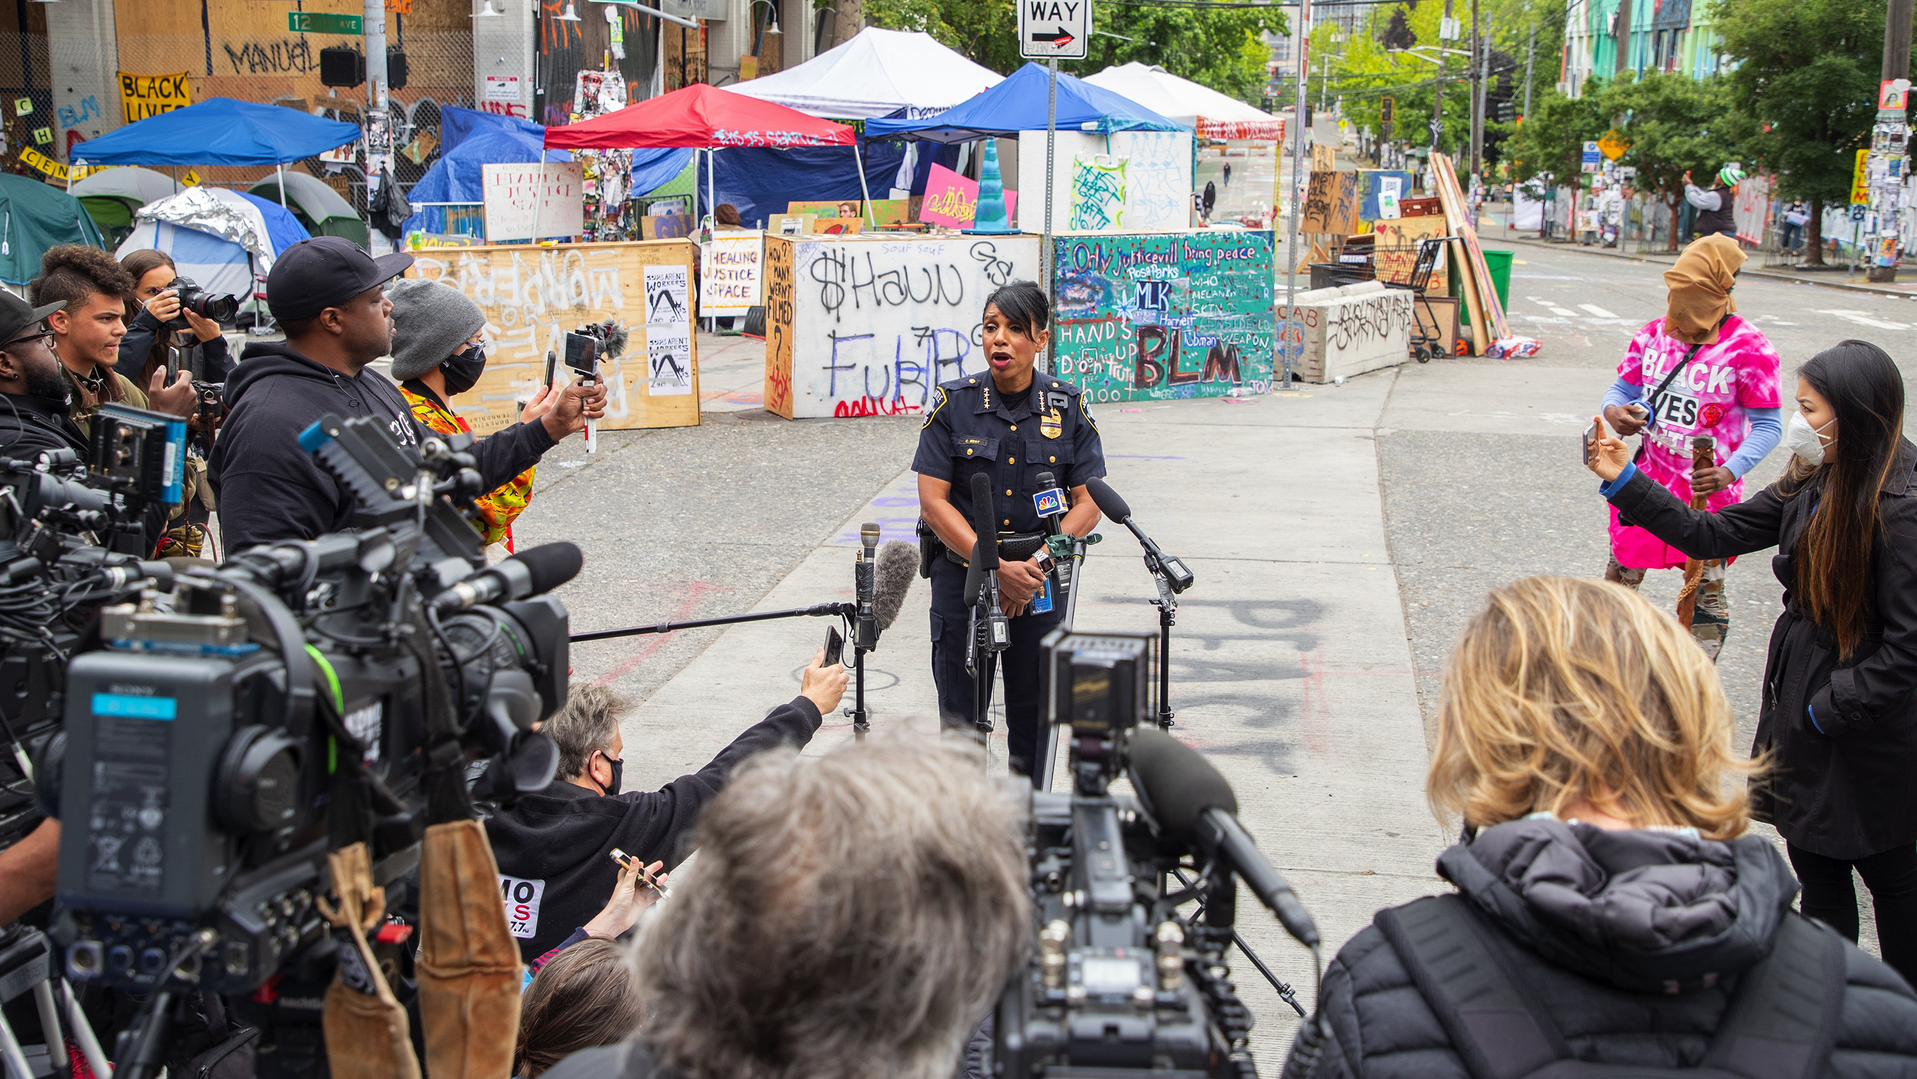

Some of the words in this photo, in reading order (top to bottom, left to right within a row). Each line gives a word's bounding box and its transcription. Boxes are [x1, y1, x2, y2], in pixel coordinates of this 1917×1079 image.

[293, 14, 311, 30] 12
[339, 20, 357, 30] AVE
[1031, 2, 1079, 21] WAY
[122, 76, 187, 99] BLACK
[57, 95, 100, 128] BLM
[125, 102, 186, 124] LIV
[503, 184, 576, 199] JUSICE
[511, 198, 554, 211] SPAE
[709, 251, 758, 265] HEALING
[1183, 239, 1212, 267] bring
[774, 264, 790, 282] MANY
[646, 280, 686, 293] WORKERS
[706, 283, 751, 299] SPACE
[1134, 281, 1171, 312] MLK
[767, 295, 793, 327] FILMED
[1061, 320, 1132, 344] HANDS
[1220, 332, 1269, 348] WEAPON
[1115, 342, 1138, 366] UP
[1134, 324, 1243, 389] BLM
[1641, 347, 1734, 395] BLACK
[1081, 377, 1138, 402] hoot
